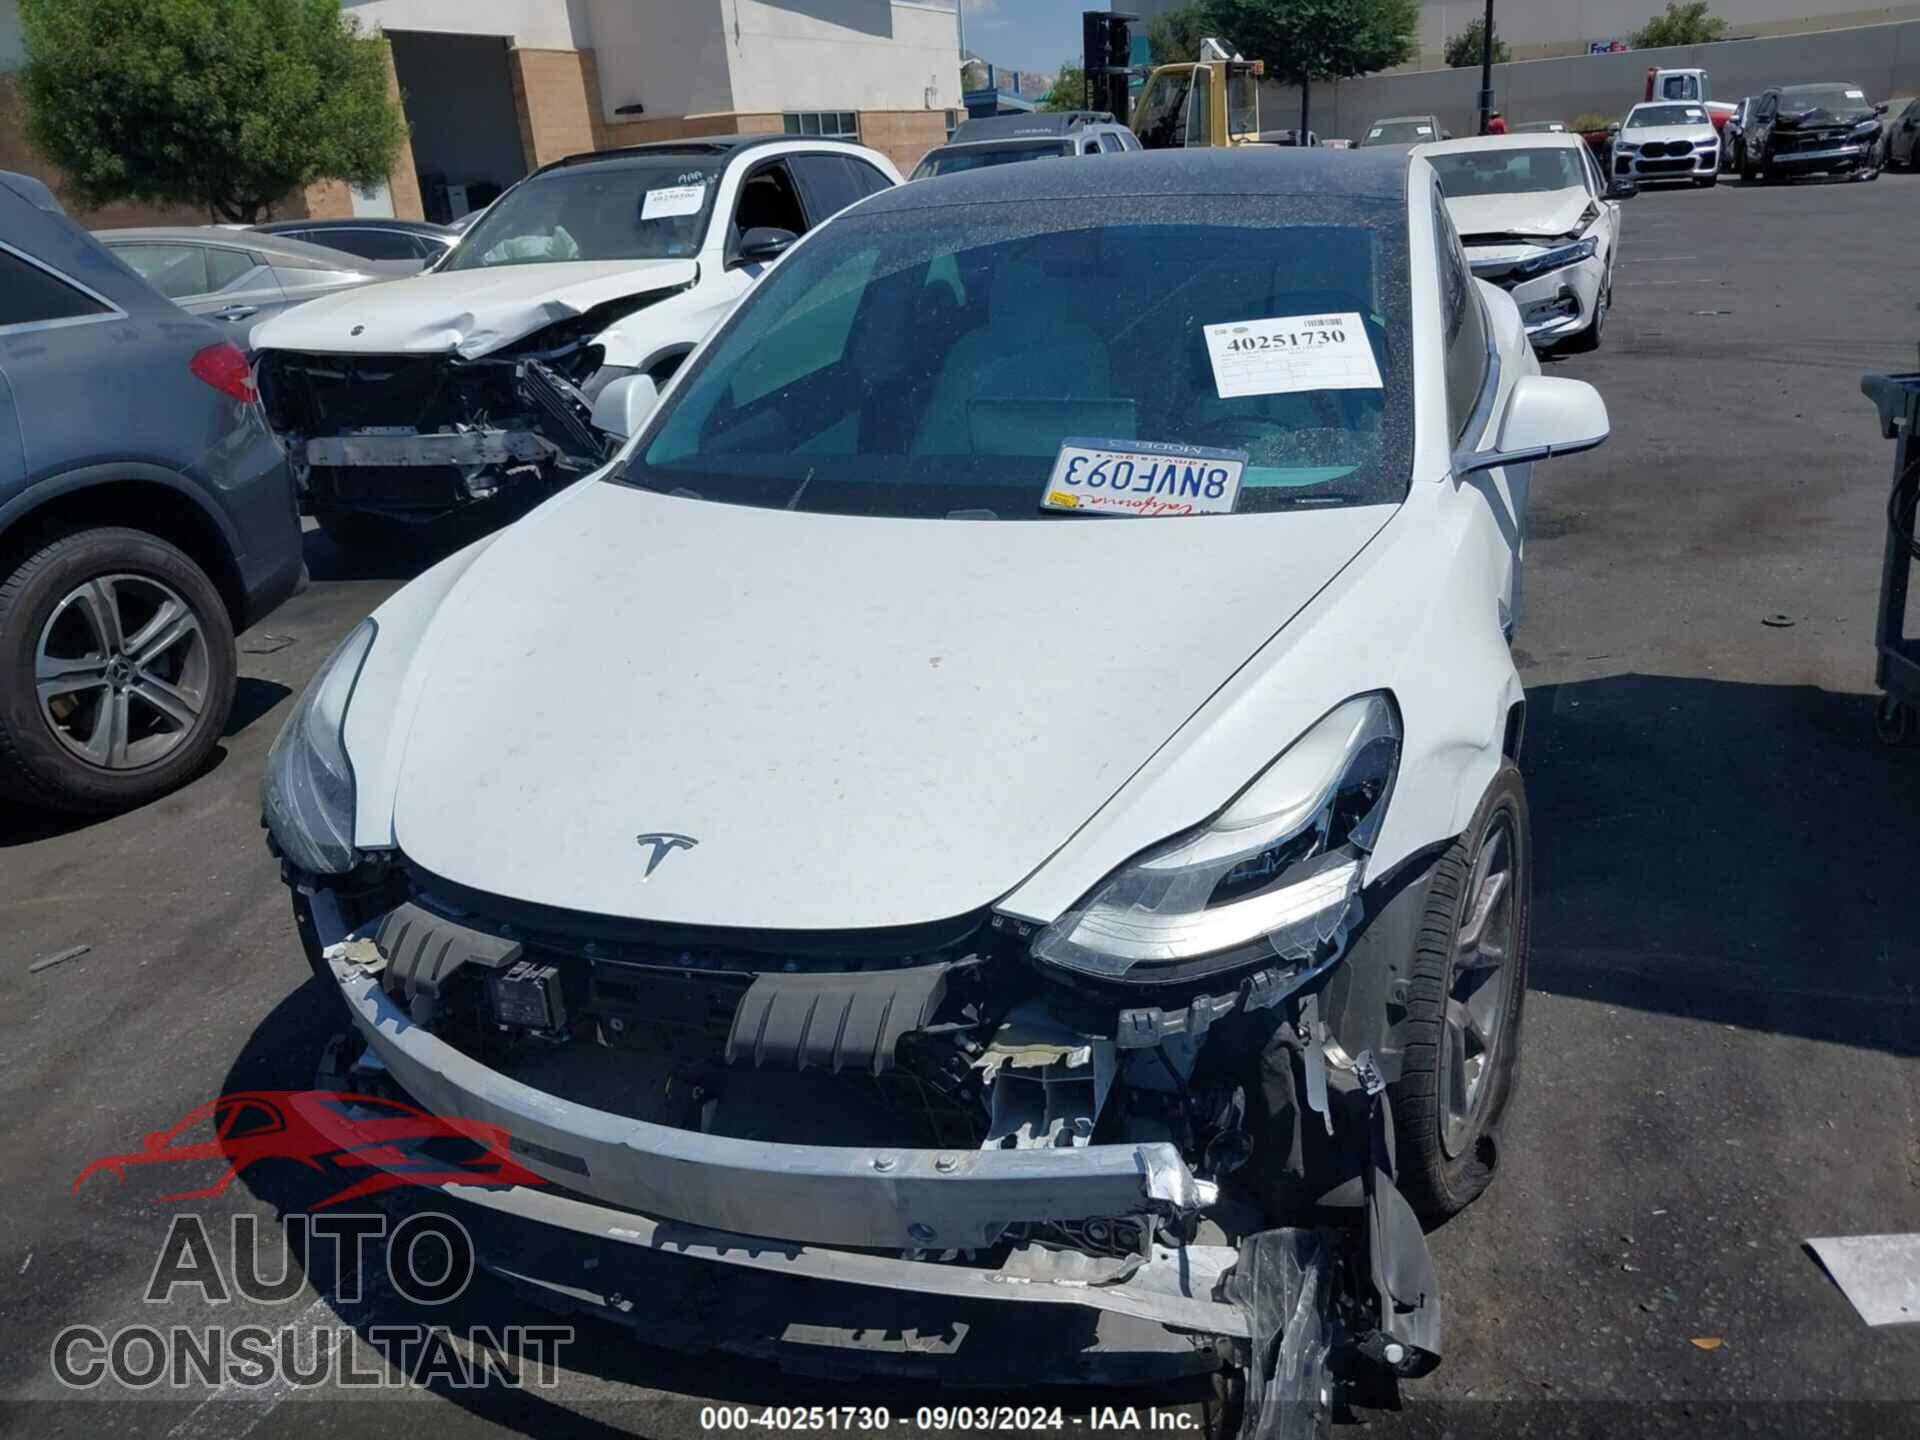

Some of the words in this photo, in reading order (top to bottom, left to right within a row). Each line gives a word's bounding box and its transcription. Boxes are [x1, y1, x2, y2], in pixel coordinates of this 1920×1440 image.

[1226, 329, 1346, 352] 40251730
[1064, 456, 1229, 499] 8NVF093
[1081, 494, 1193, 516] California
